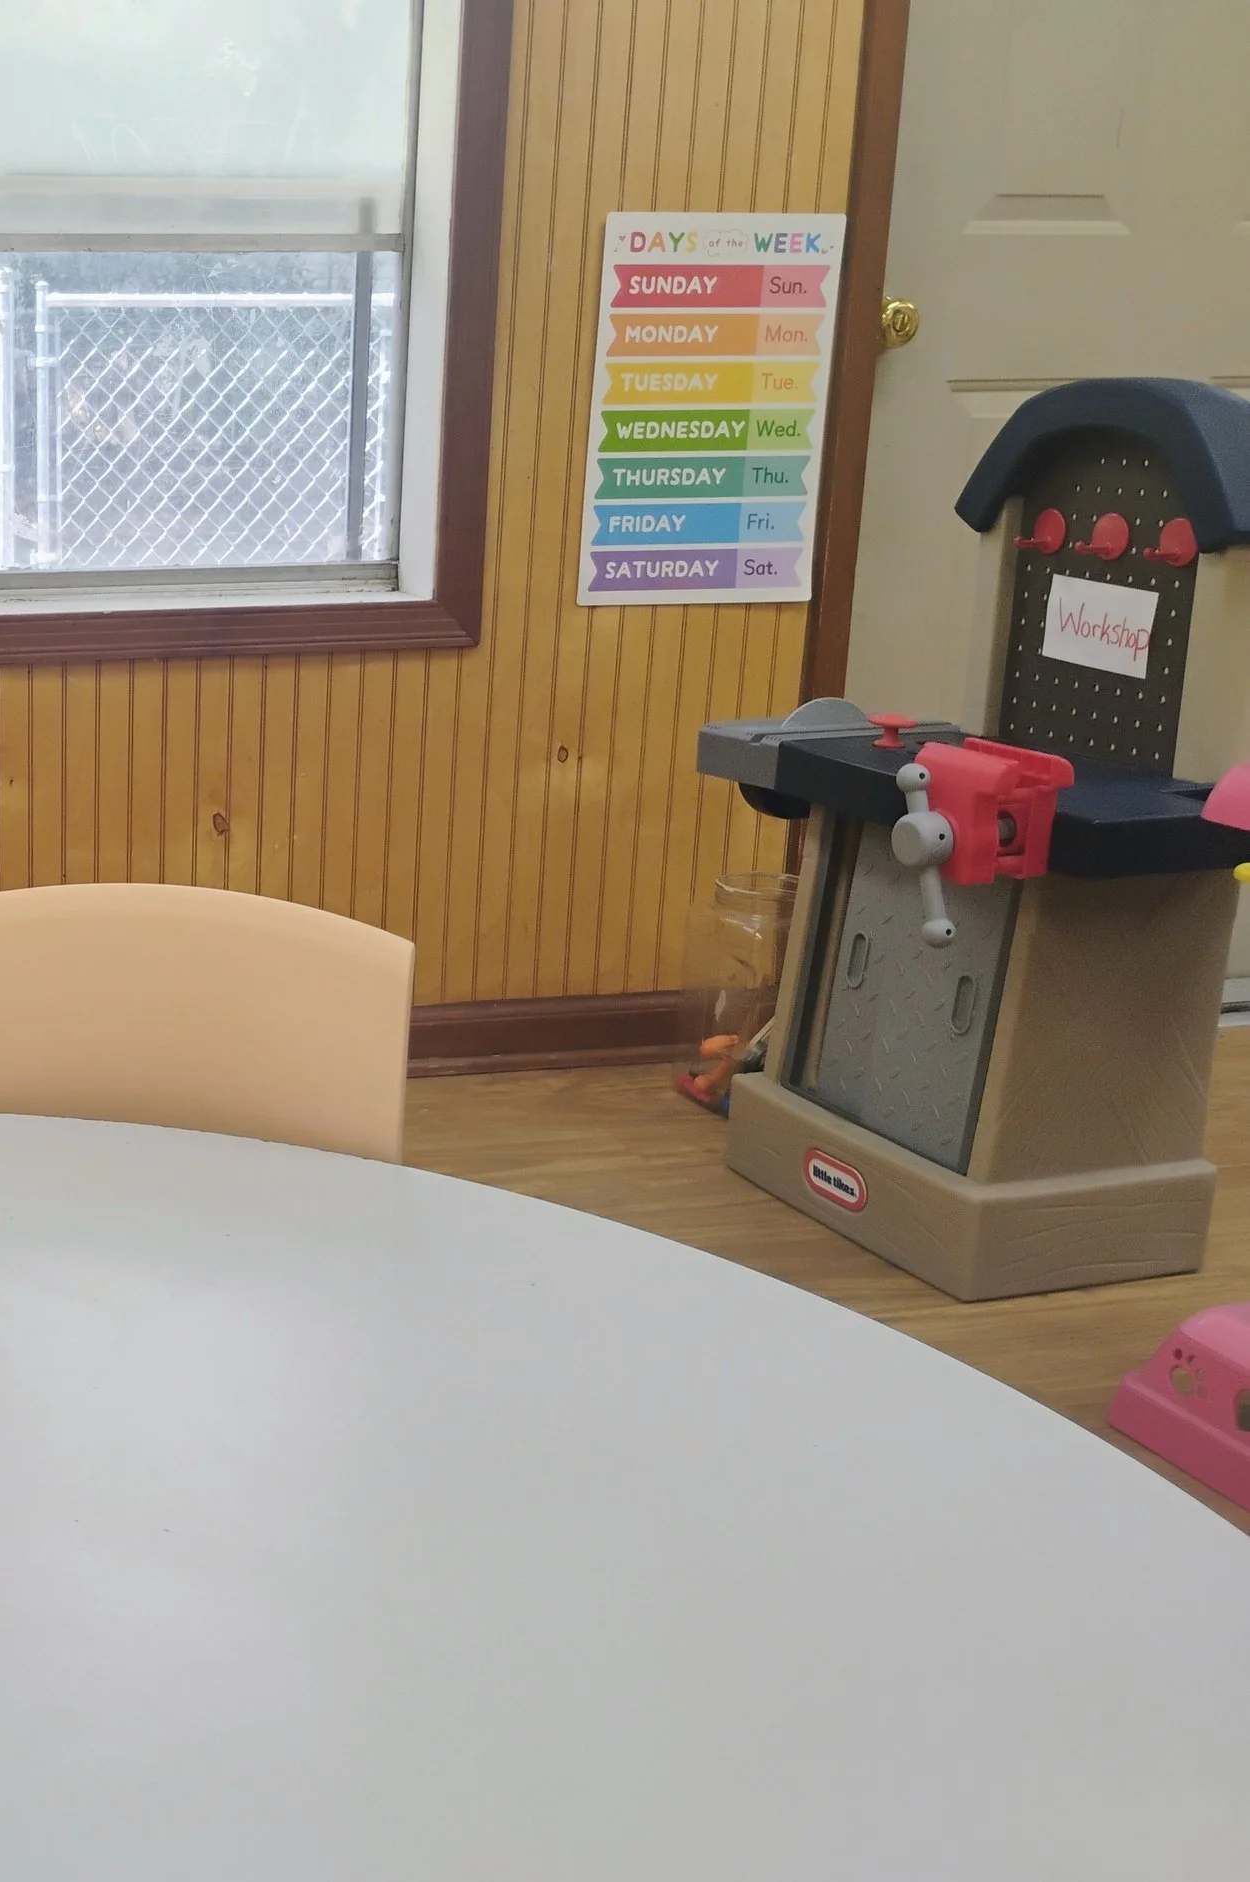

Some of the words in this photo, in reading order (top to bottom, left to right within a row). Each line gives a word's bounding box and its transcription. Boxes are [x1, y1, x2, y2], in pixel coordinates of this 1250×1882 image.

[630, 231, 697, 253] DAYS
[708, 238, 720, 248] of
[726, 238, 743, 248] the
[754, 232, 821, 253] WEEK
[628, 275, 718, 294] SUNDAY
[769, 276, 807, 294] Sun.
[625, 325, 719, 343] MONDAY
[765, 325, 808, 342] Mon.
[621, 372, 719, 392] TUESDAY
[761, 373, 798, 390] Tue.
[616, 420, 746, 439] WEDNESDAY
[756, 420, 801, 437] Wed.
[612, 467, 726, 486] THURSDAY
[752, 467, 789, 484] Thu.
[608, 514, 686, 533] FRIDAY
[747, 513, 775, 530] Fri.
[605, 560, 719, 579] SATURDAY
[743, 559, 778, 576] Sat.
[1059, 596, 1151, 662] Workshop
[813, 1164, 832, 1185] little
[833, 1176, 854, 1196] tikes
